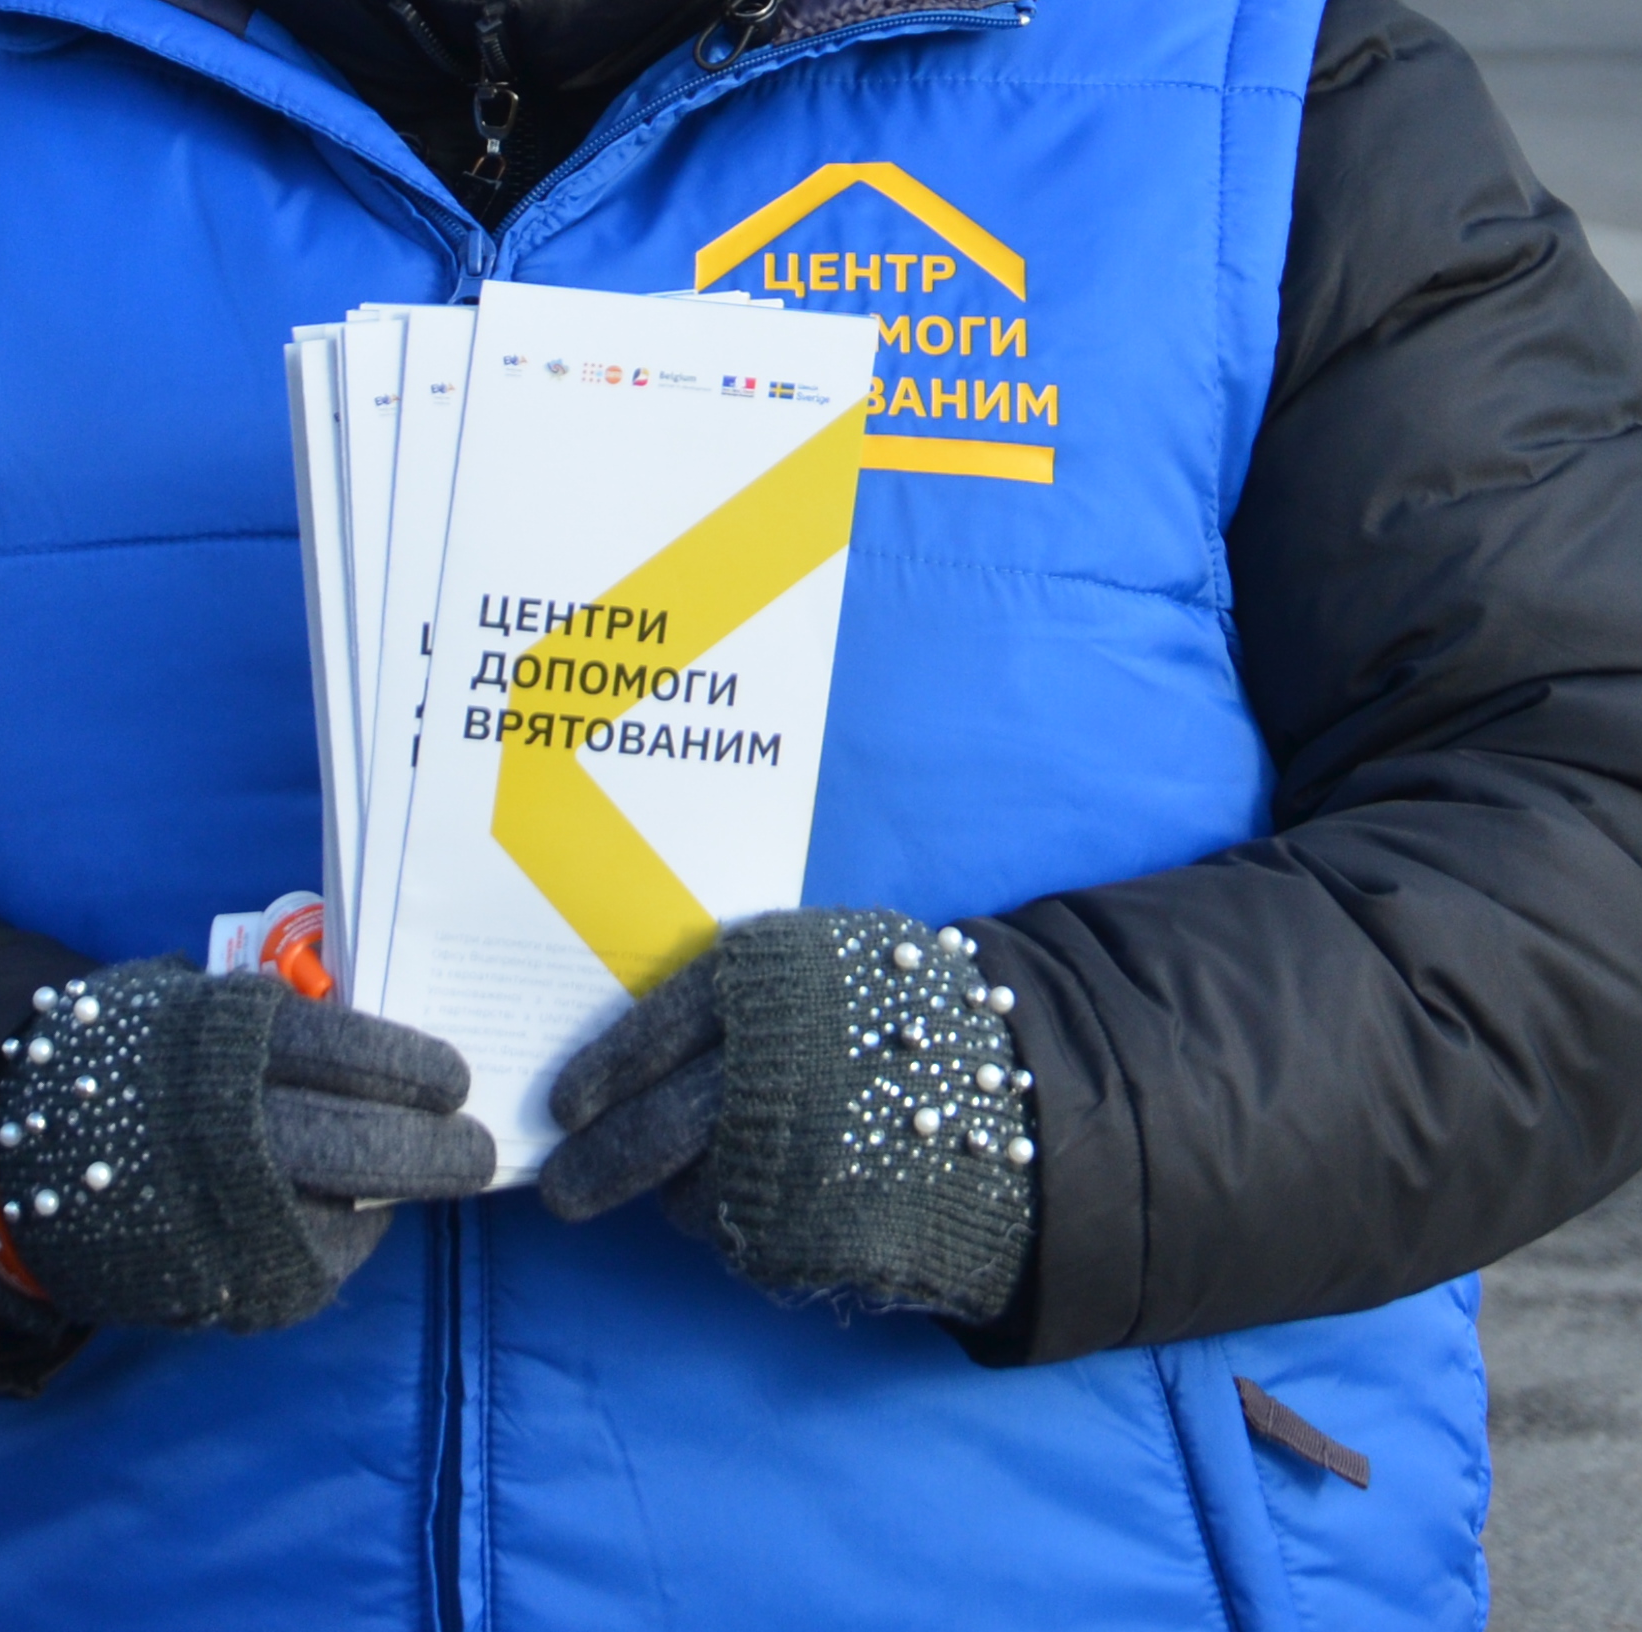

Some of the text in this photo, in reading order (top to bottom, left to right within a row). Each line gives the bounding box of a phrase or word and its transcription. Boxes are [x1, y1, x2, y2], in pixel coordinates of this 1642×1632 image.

[763, 252, 957, 298] ЦЕНТР
[869, 313, 1027, 358] МОГИ
[865, 375, 1059, 426] ВАНИМ
[478, 594, 669, 645] ЦЕНТРИ
[470, 650, 739, 707] ДОПОМОГИ
[462, 705, 783, 767] ВРЯТОВАНИМ
